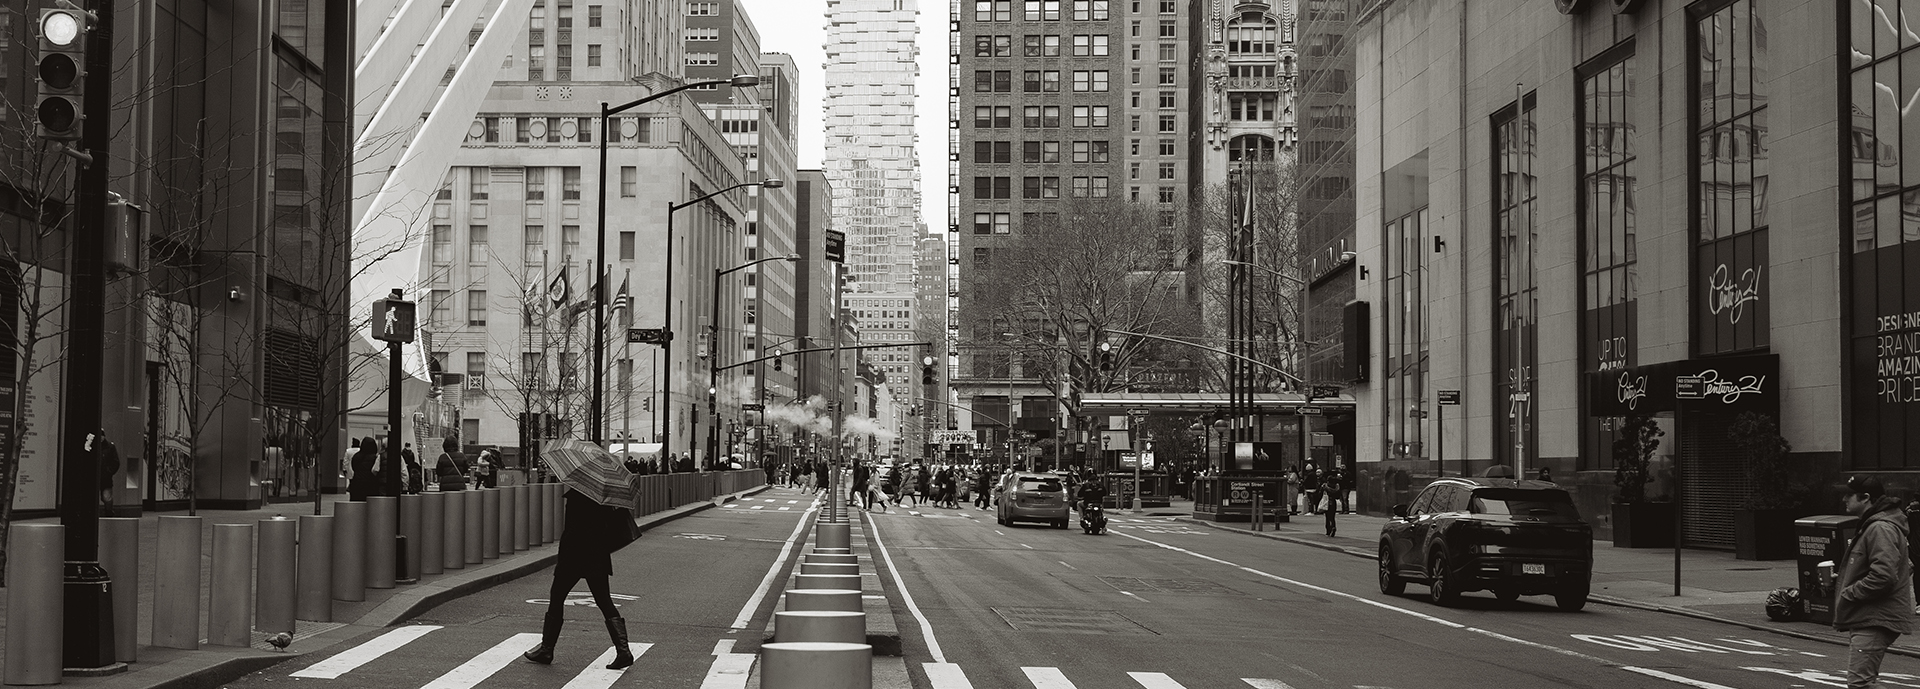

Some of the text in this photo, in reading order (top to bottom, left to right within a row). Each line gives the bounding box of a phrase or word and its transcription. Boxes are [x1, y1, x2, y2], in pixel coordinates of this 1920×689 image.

[1709, 263, 1762, 325] Century 21
[1598, 336, 1626, 361] UP TO
[1738, 375, 1766, 393] 21
